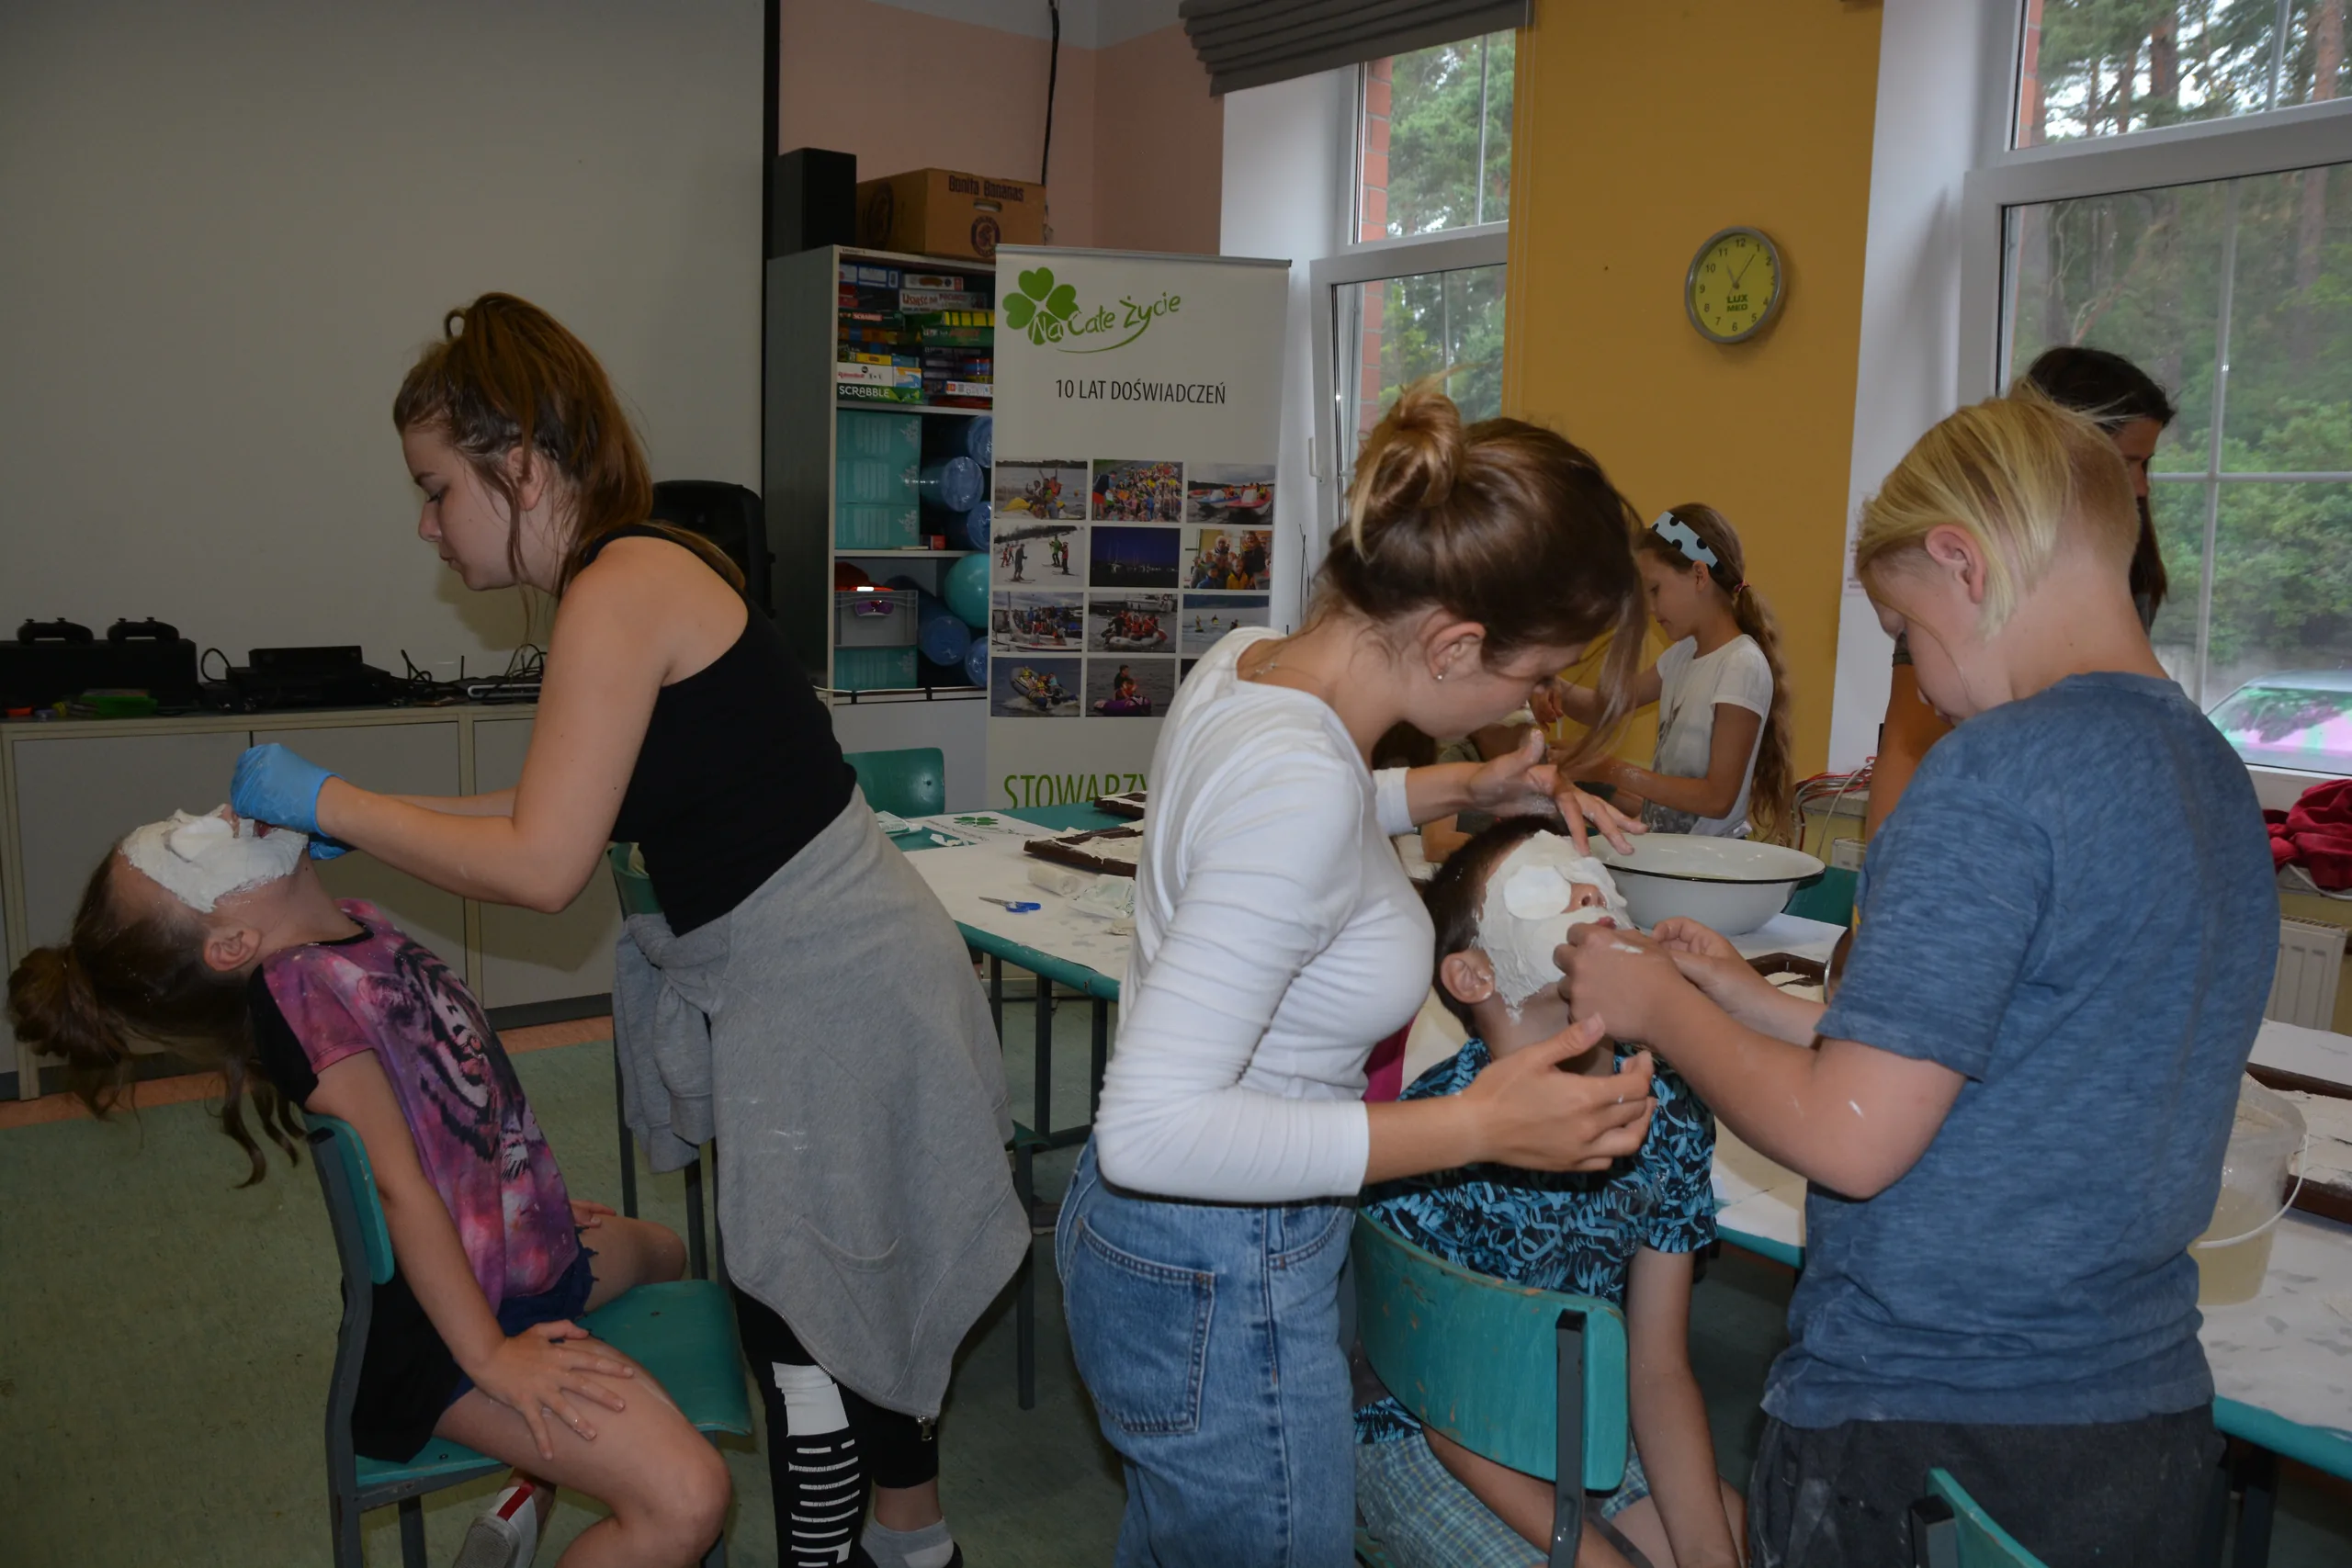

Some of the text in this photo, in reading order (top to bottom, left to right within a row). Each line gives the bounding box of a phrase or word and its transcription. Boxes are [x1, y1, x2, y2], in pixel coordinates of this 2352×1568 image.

[948, 175, 1024, 202] Bonita Bananas
[1736, 238, 1747, 248] 12
[1718, 248, 1728, 257] 11
[1765, 256, 1771, 266] 2
[1706, 263, 1716, 273] 10
[1700, 284, 1706, 294] 9
[1726, 294, 1748, 304] LUX
[1704, 303, 1710, 312] 8
[1726, 304, 1748, 312] MED
[1030, 291, 1182, 341] Na Całe Życie
[1715, 316, 1721, 326] 7
[1751, 313, 1757, 322] 5
[1732, 321, 1737, 332] 6
[838, 385, 890, 398] SCRABBLE
[1056, 378, 1226, 404] 10 LAT DOŚWIADCZEŃ
